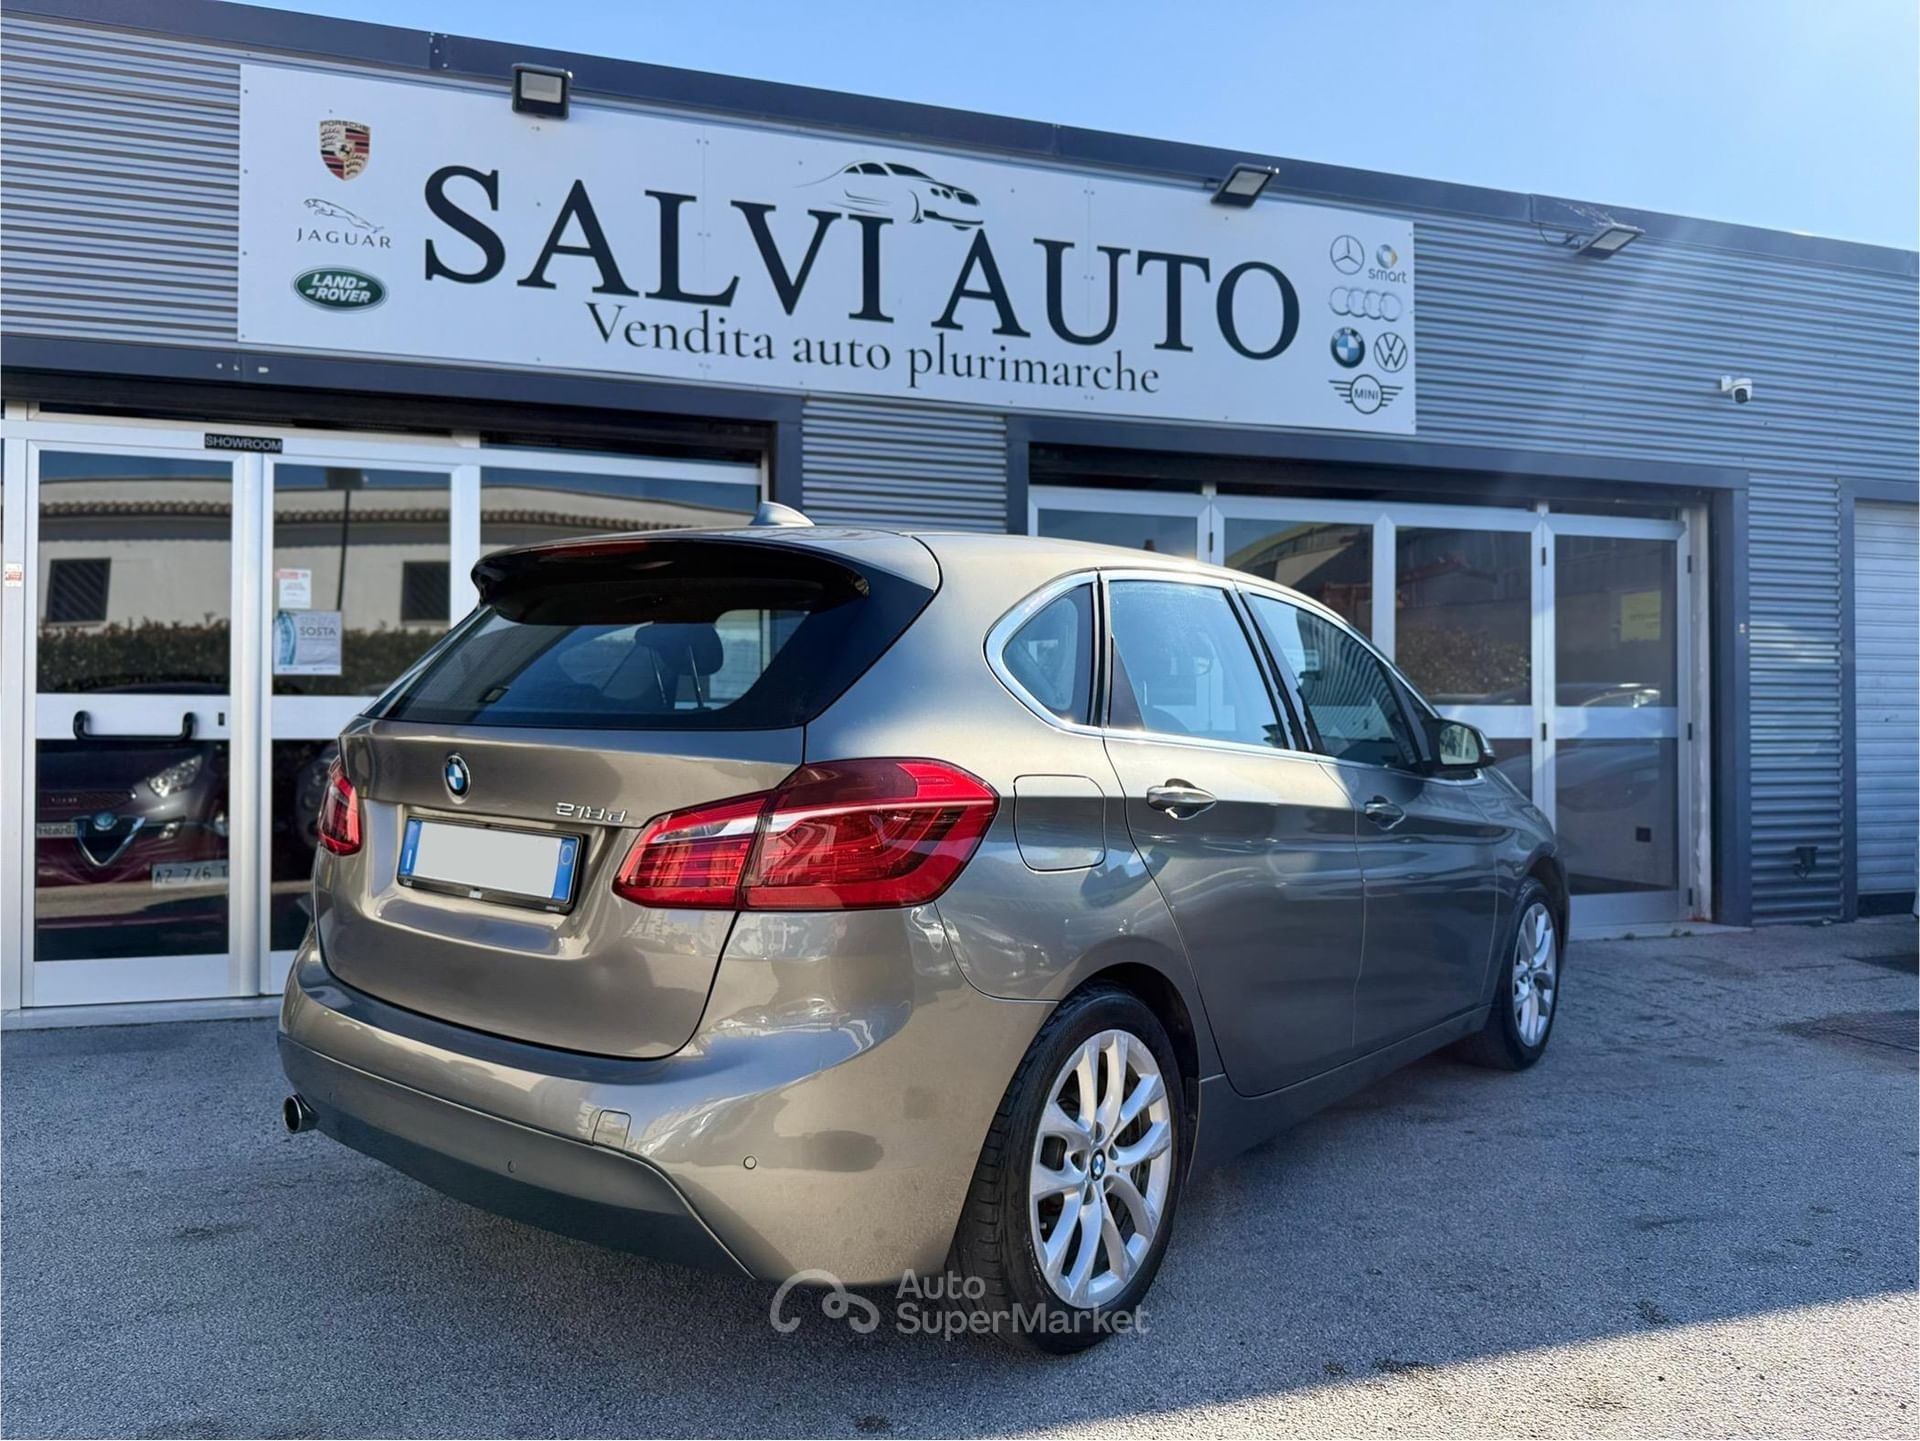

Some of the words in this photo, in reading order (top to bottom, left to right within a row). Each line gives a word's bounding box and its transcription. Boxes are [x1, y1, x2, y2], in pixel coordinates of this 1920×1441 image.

[320, 119, 370, 131] PORSCHE
[297, 227, 391, 248] JAGUAR
[424, 165, 894, 322] SALVI
[931, 229, 1300, 360] AUTO
[312, 274, 357, 289] LAND
[1368, 268, 1407, 283] smart
[315, 287, 371, 303] ROVER
[585, 302, 775, 361] Vendita
[792, 337, 891, 371] auto
[906, 333, 1160, 395] plurimarche
[1354, 388, 1379, 401] MINI
[206, 435, 282, 451] SHOWROOM
[299, 626, 337, 637] SOSTA
